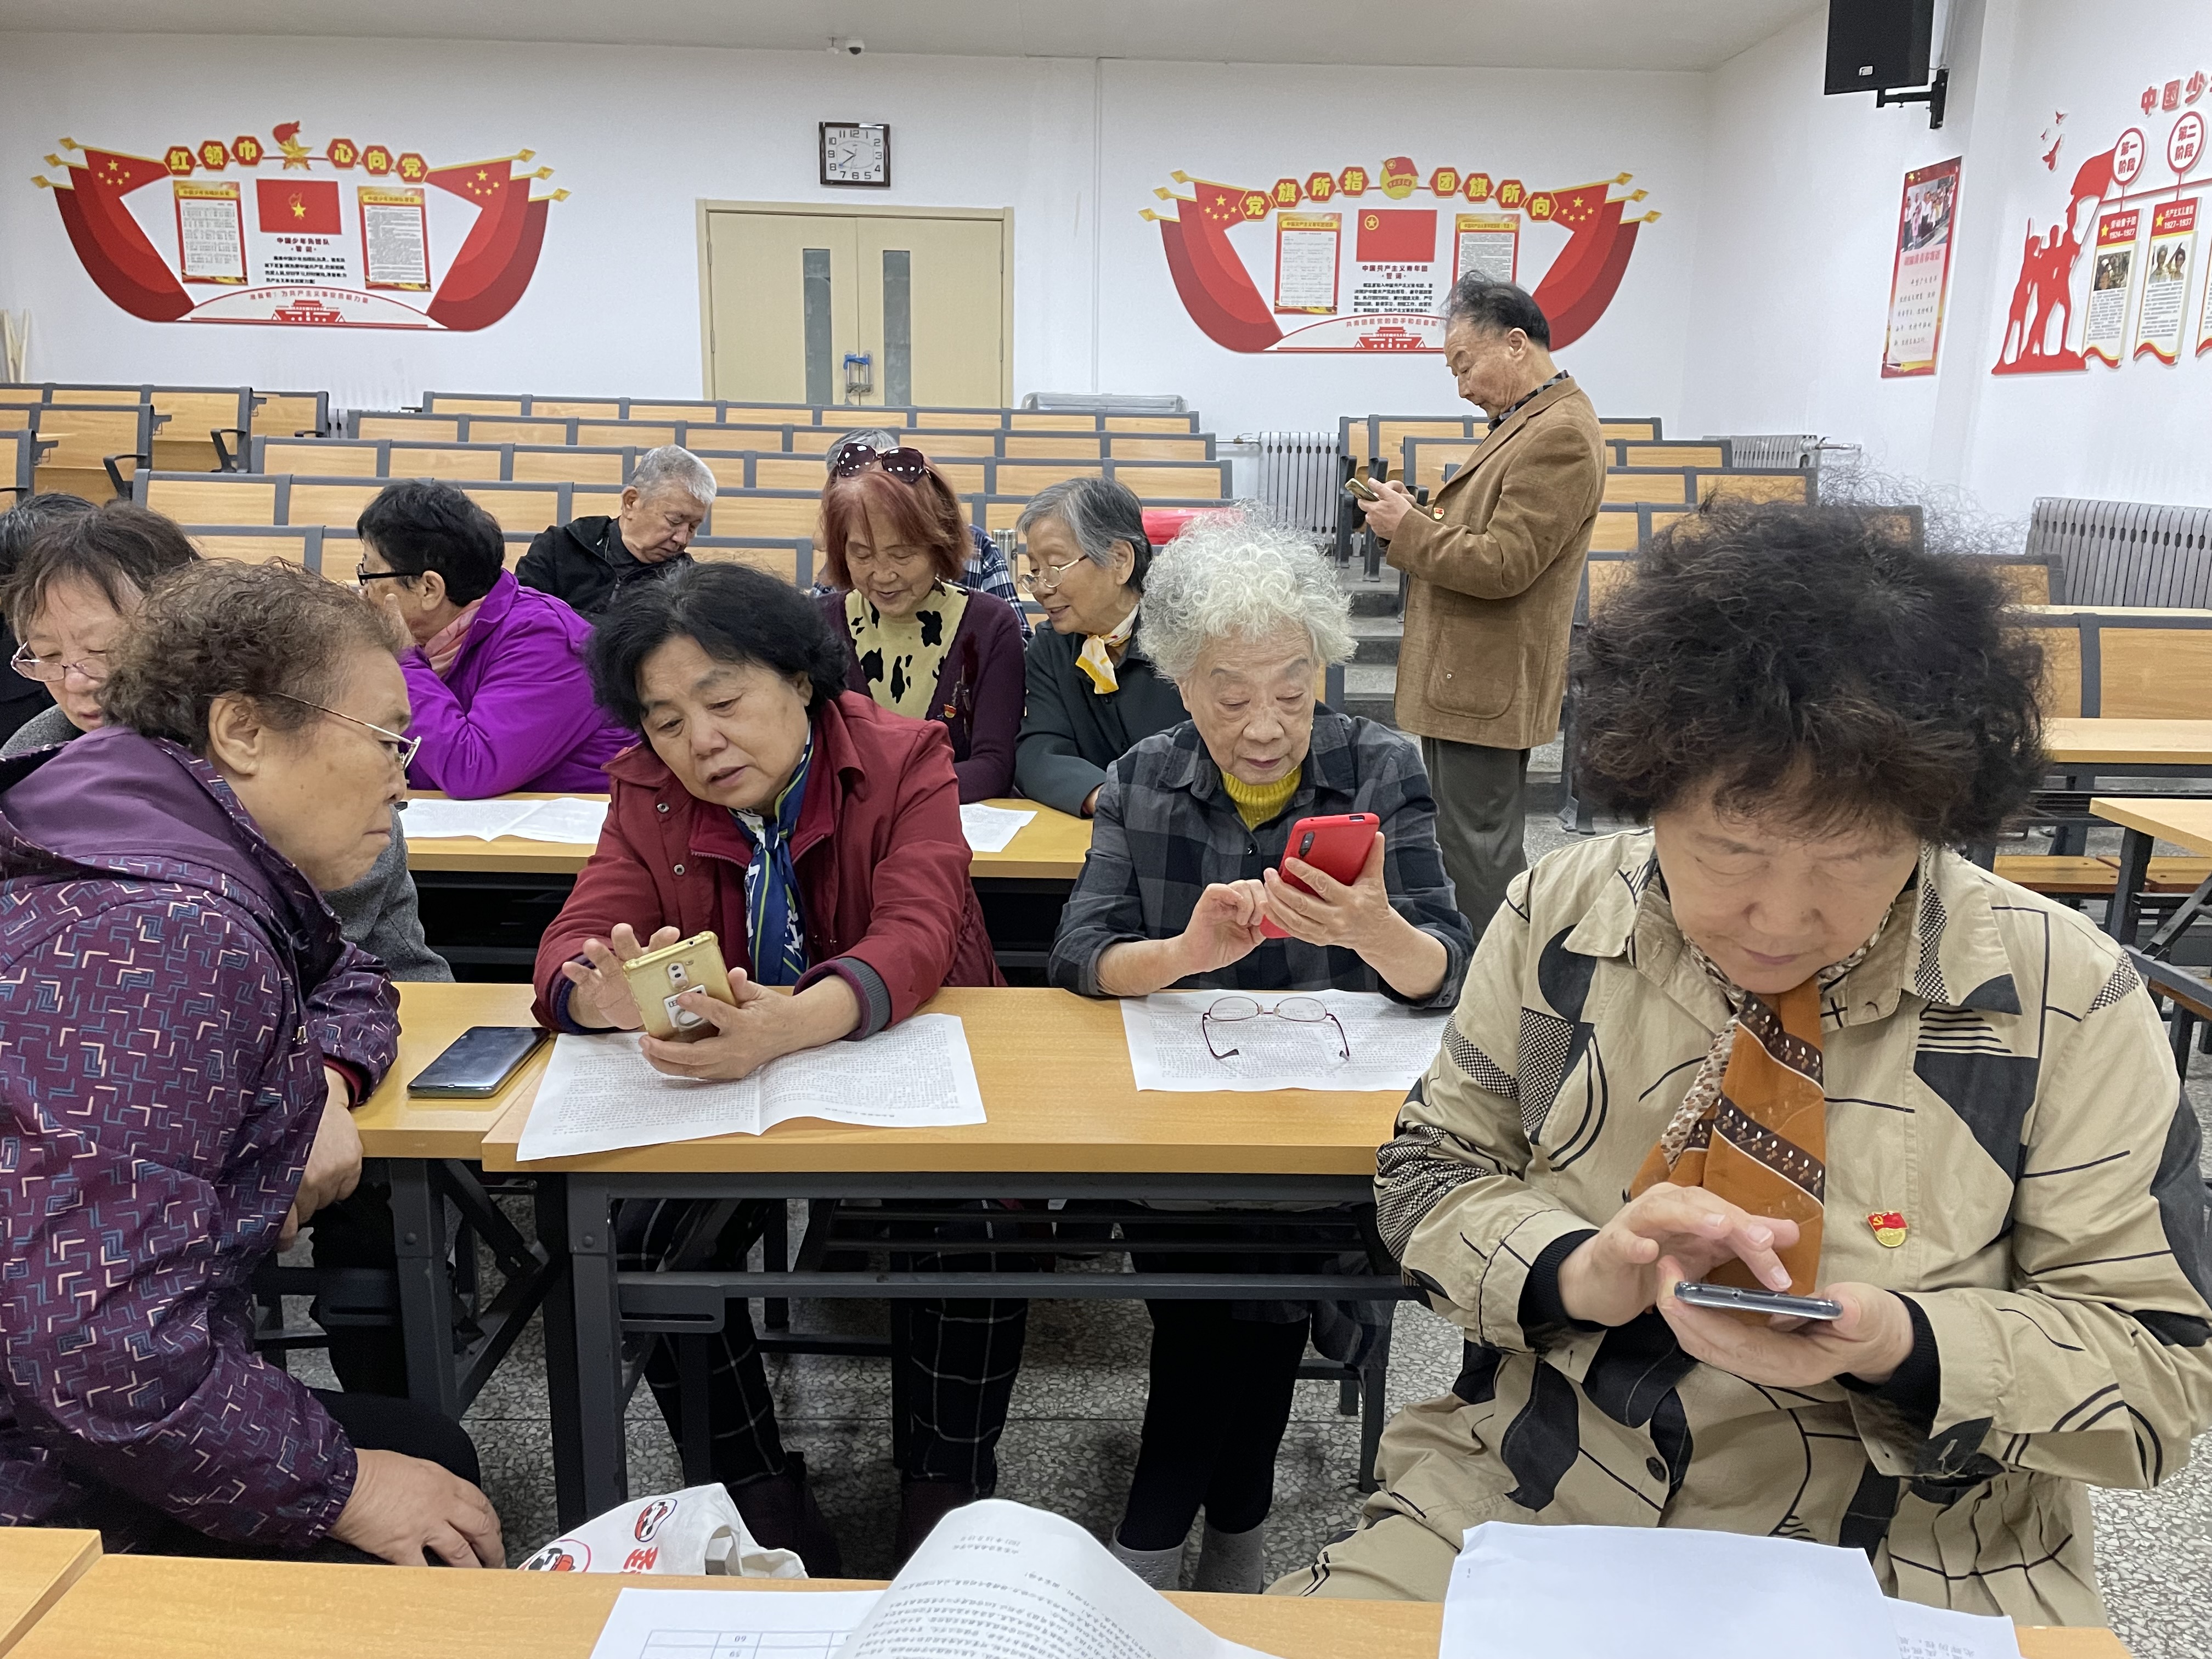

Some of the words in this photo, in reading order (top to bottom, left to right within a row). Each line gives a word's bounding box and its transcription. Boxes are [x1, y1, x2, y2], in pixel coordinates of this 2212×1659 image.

[2141, 70, 2212, 116] 中国少
[839, 129, 845, 138] 11
[850, 129, 860, 138] 12
[866, 130, 868, 139] 1
[2178, 124, 2197, 141] 第二
[828, 137, 837, 145] 10
[873, 138, 881, 146] 2
[2120, 141, 2138, 156] 第一
[2174, 143, 2194, 161] 阶段
[875, 151, 882, 160] 3
[2118, 157, 2136, 174] 阶段
[840, 171, 846, 179] 7
[864, 171, 872, 179] 5
